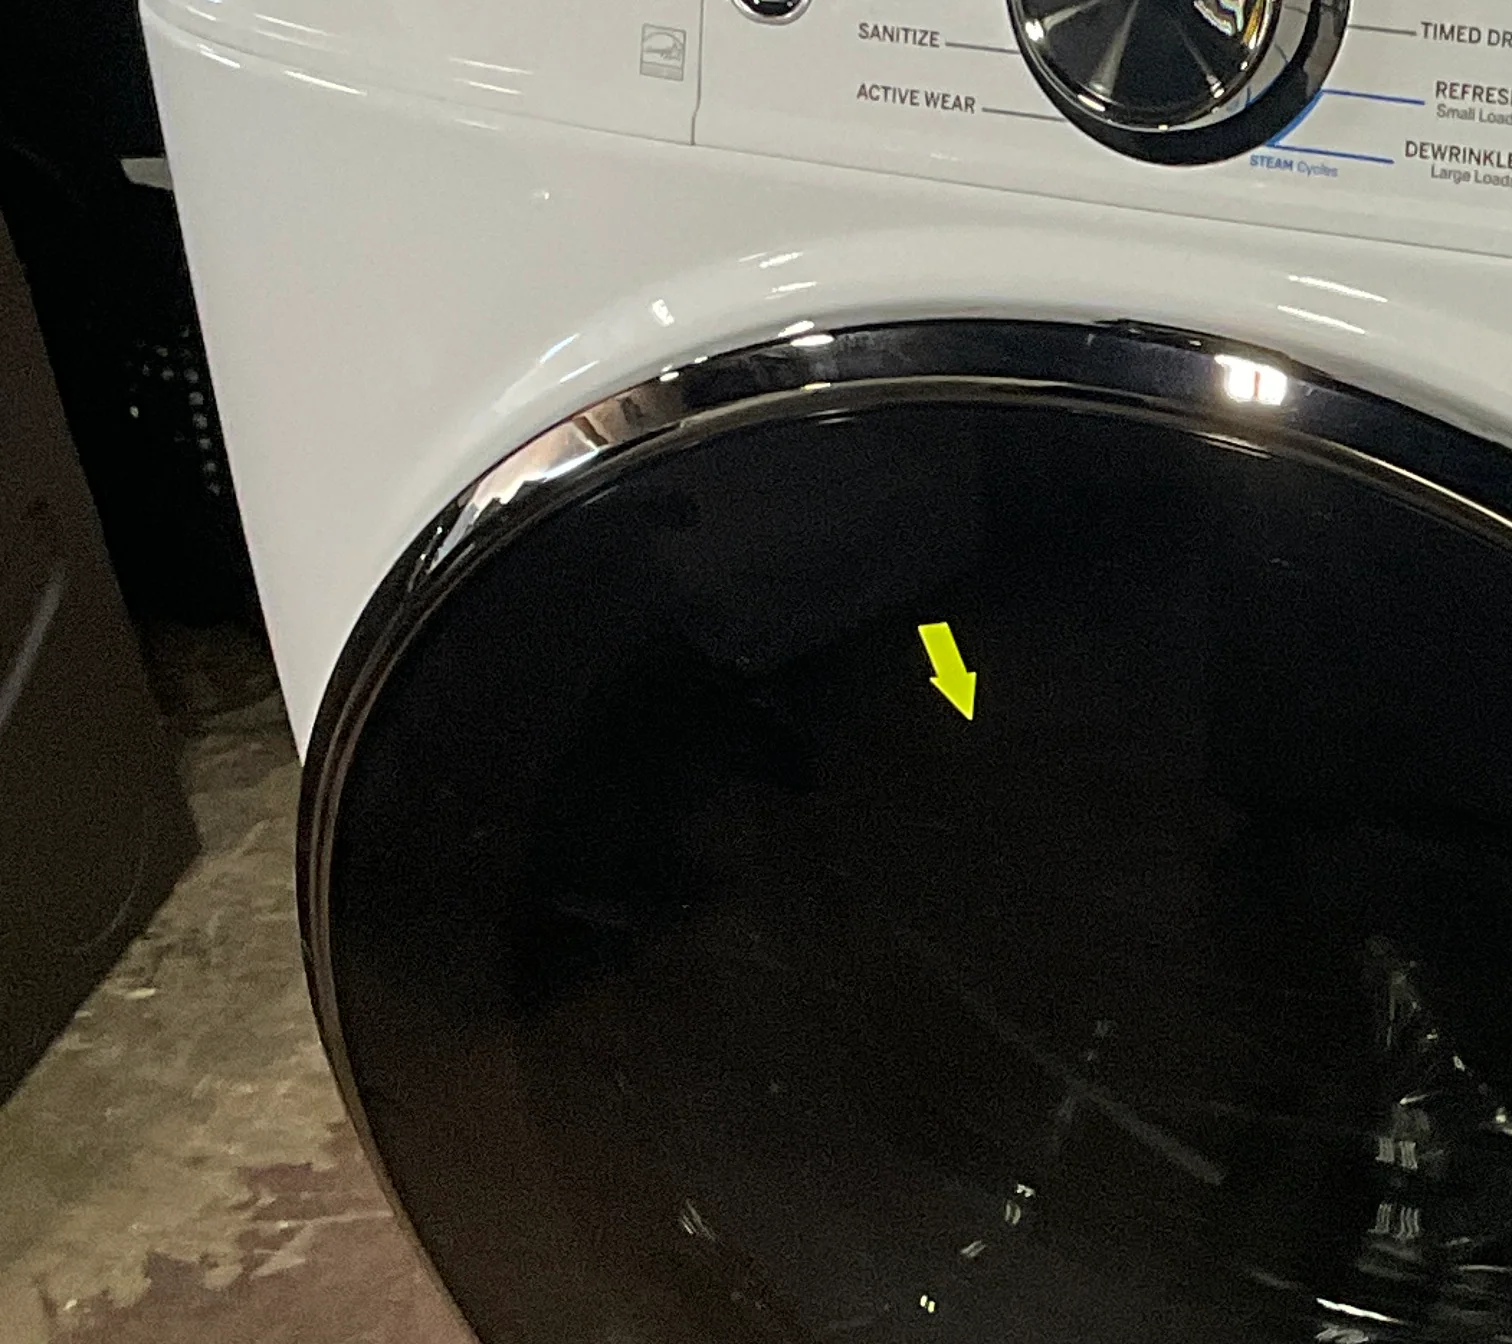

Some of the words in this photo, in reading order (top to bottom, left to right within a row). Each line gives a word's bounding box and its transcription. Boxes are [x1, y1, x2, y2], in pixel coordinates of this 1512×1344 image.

[857, 22, 940, 48] SANITIZE
[1420, 21, 1482, 44] TIMED
[856, 83, 921, 107] ACTIVE
[924, 91, 976, 114] WEAR
[1436, 104, 1476, 122] Small
[1250, 154, 1294, 172] STEAM
[1296, 160, 1339, 178] Cycles
[1430, 163, 1472, 184] Large
